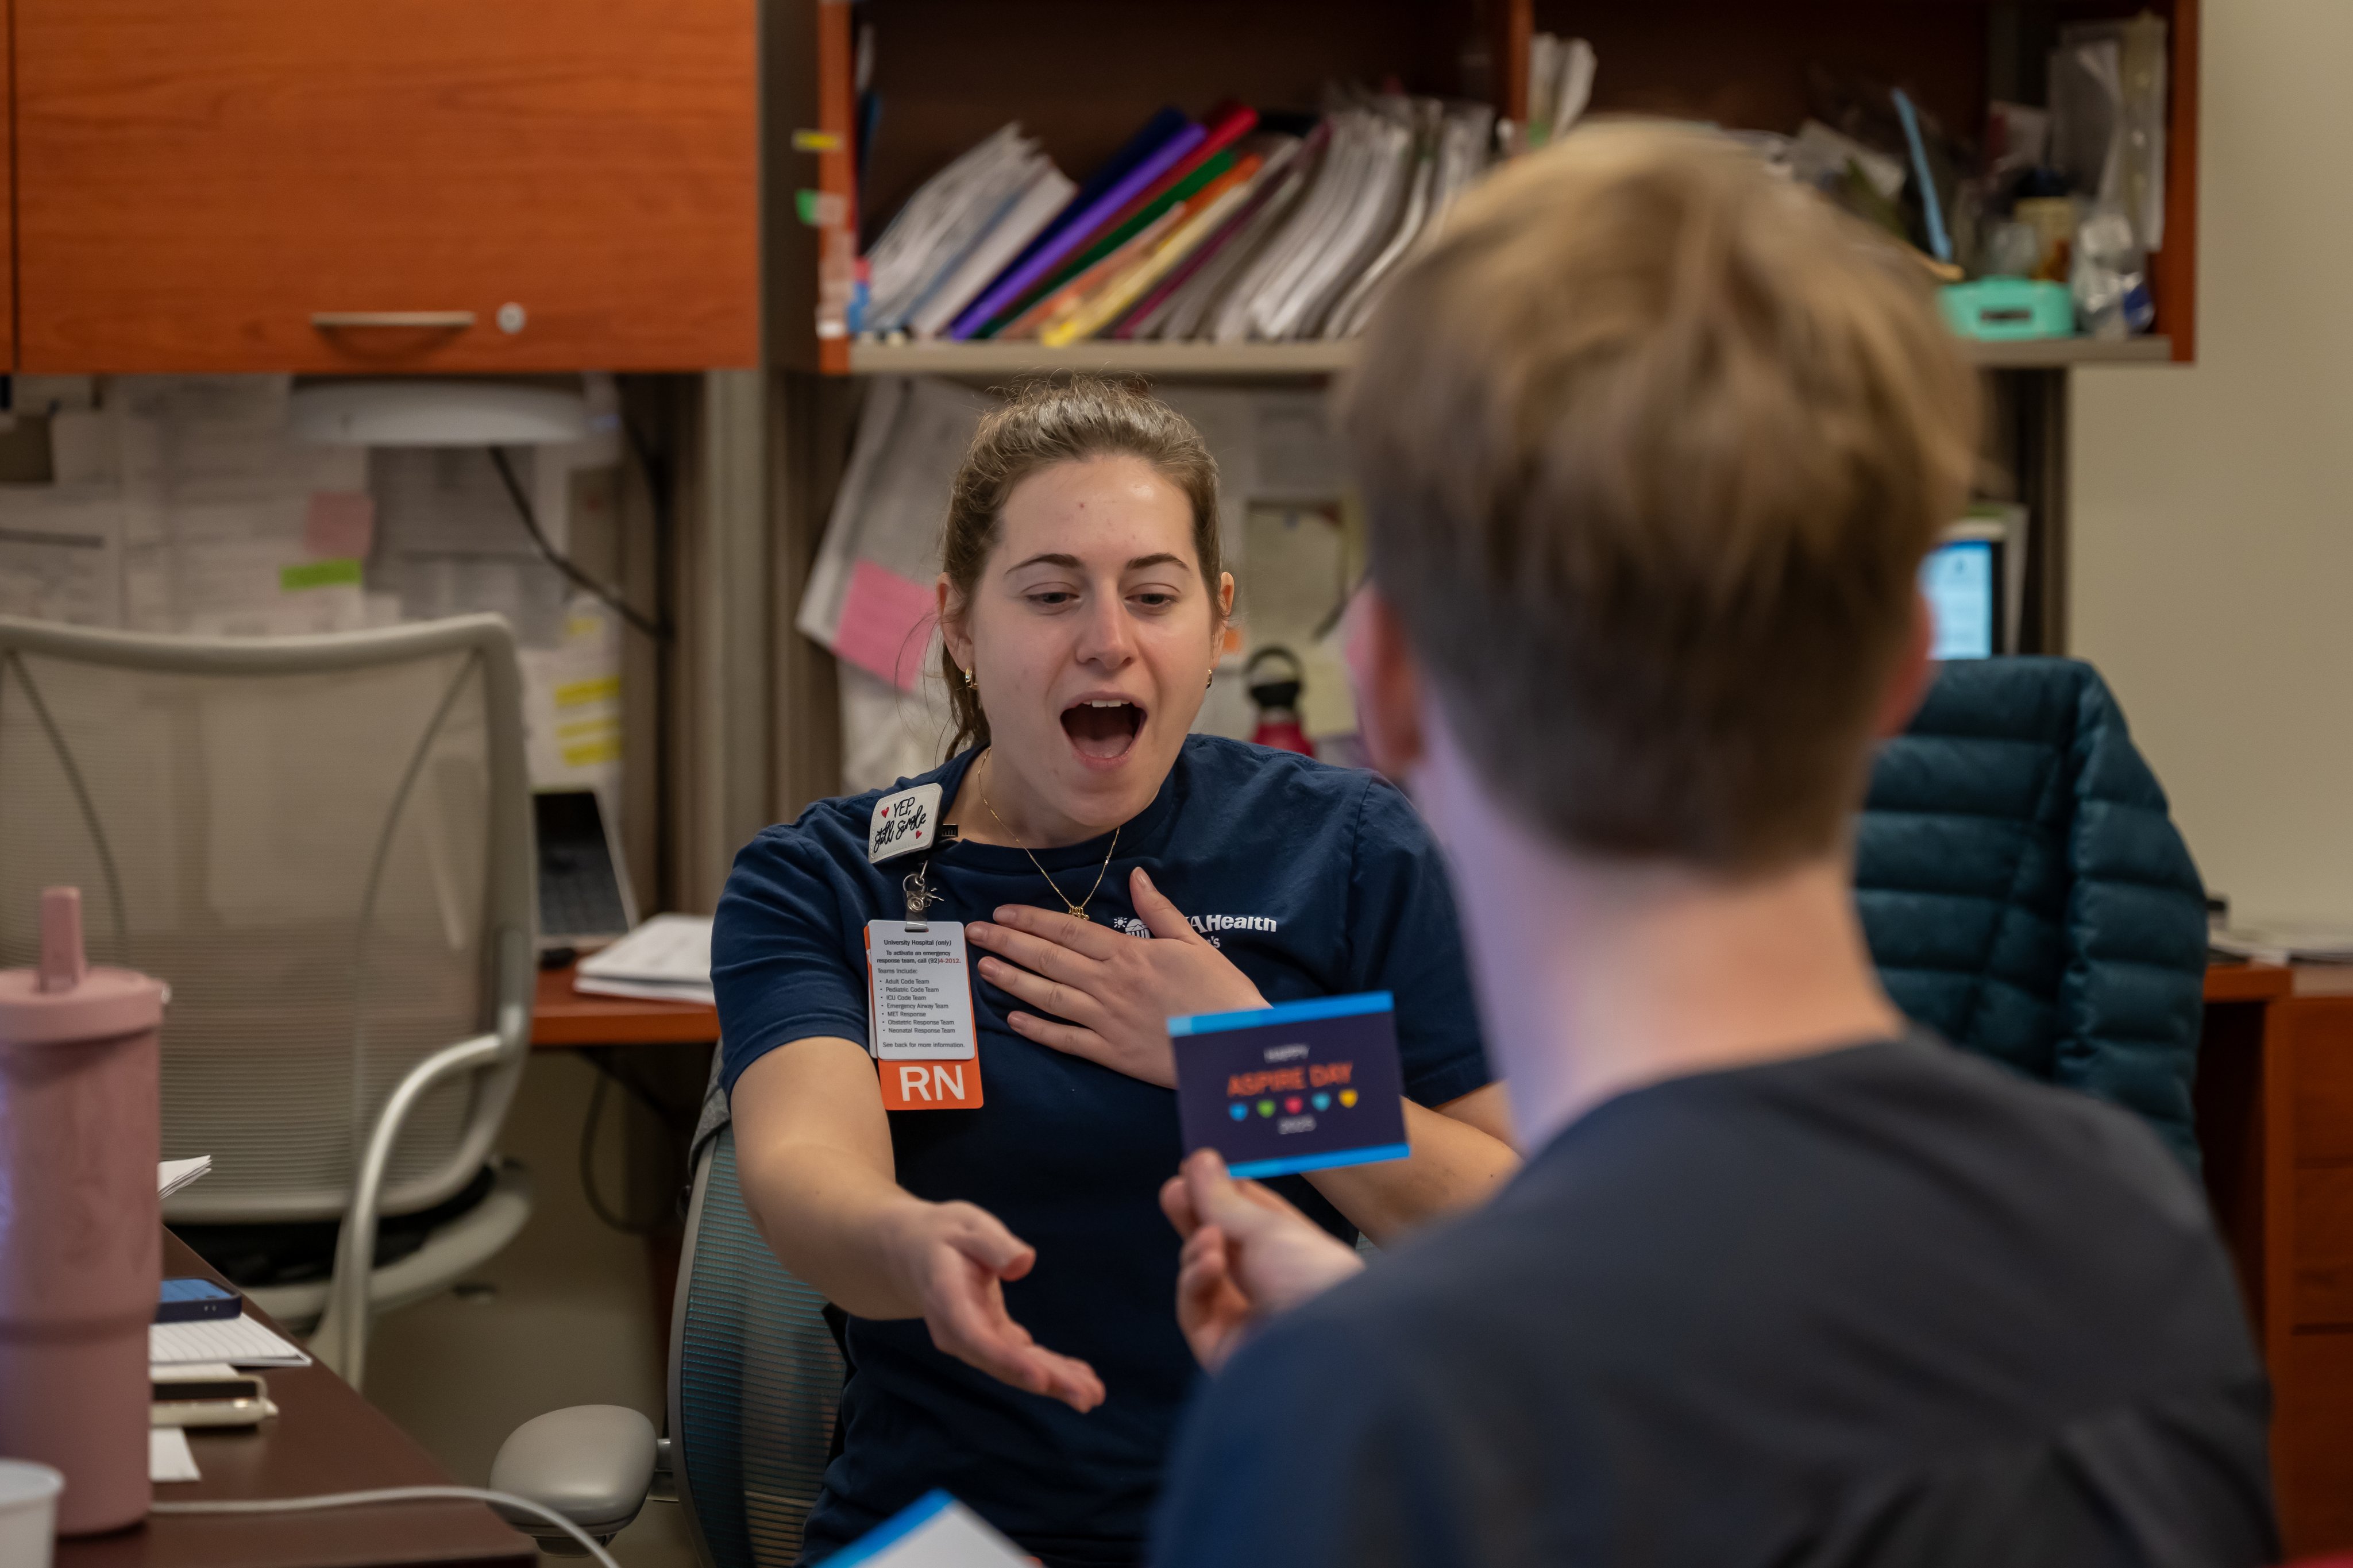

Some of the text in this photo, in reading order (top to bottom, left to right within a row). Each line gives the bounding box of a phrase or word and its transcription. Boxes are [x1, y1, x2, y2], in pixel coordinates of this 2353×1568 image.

[893, 797, 916, 818] YEP,
[873, 820, 894, 853] still
[1206, 914, 1276, 933] Health
[899, 1065, 965, 1102] RN
[1227, 1061, 1353, 1098] ASPIRE DAY
